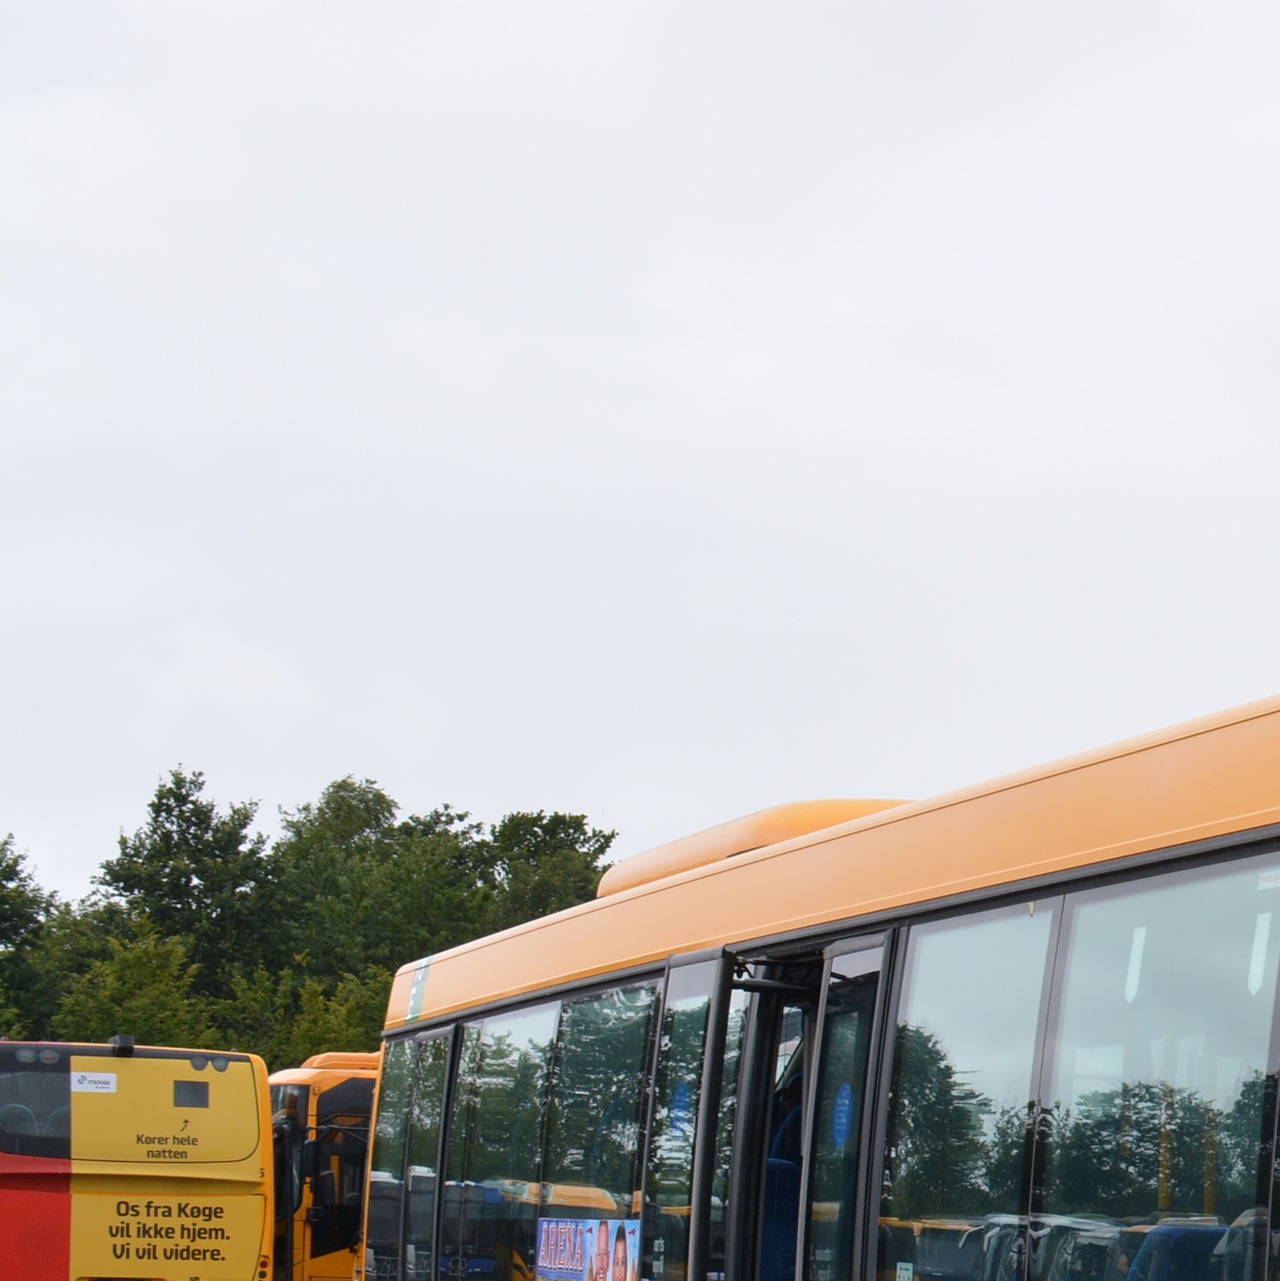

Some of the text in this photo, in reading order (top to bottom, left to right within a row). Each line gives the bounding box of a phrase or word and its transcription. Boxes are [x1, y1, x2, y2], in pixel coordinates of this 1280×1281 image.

[136, 1134, 198, 1146] Kører hele
[147, 1149, 188, 1160] natten
[116, 1201, 224, 1222] Os fra Køge
[109, 1221, 230, 1242] vil ikke hjem.
[112, 1243, 226, 1261] Vi vil videre.
[538, 1222, 584, 1272] ARENA
